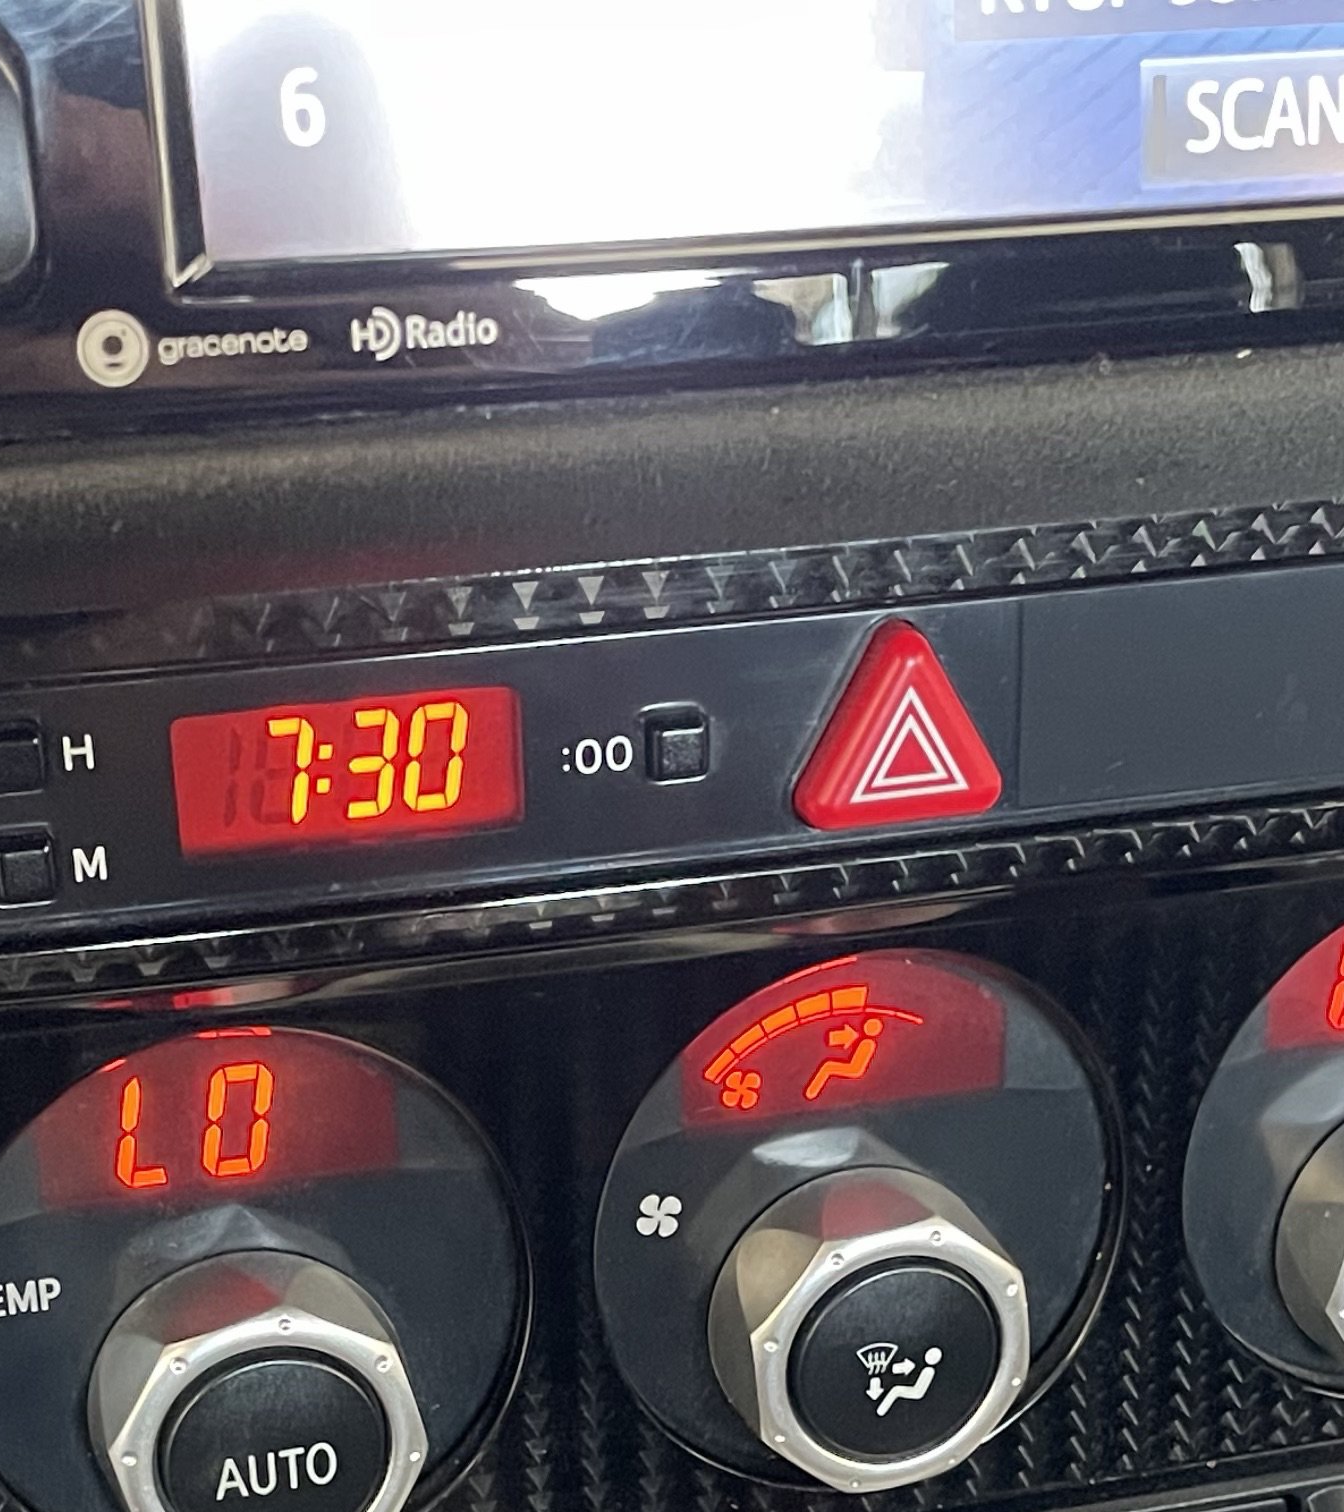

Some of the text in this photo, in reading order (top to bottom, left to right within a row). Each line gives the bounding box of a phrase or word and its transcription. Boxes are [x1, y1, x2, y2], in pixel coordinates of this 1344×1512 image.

[278, 66, 327, 148] 6
[157, 325, 309, 366] gracenote
[405, 313, 499, 350] Radio
[61, 734, 96, 772] H
[267, 700, 470, 826] 7:30
[560, 734, 634, 777] :00
[71, 845, 109, 882] M
[214, 1440, 338, 1502] AUTO
